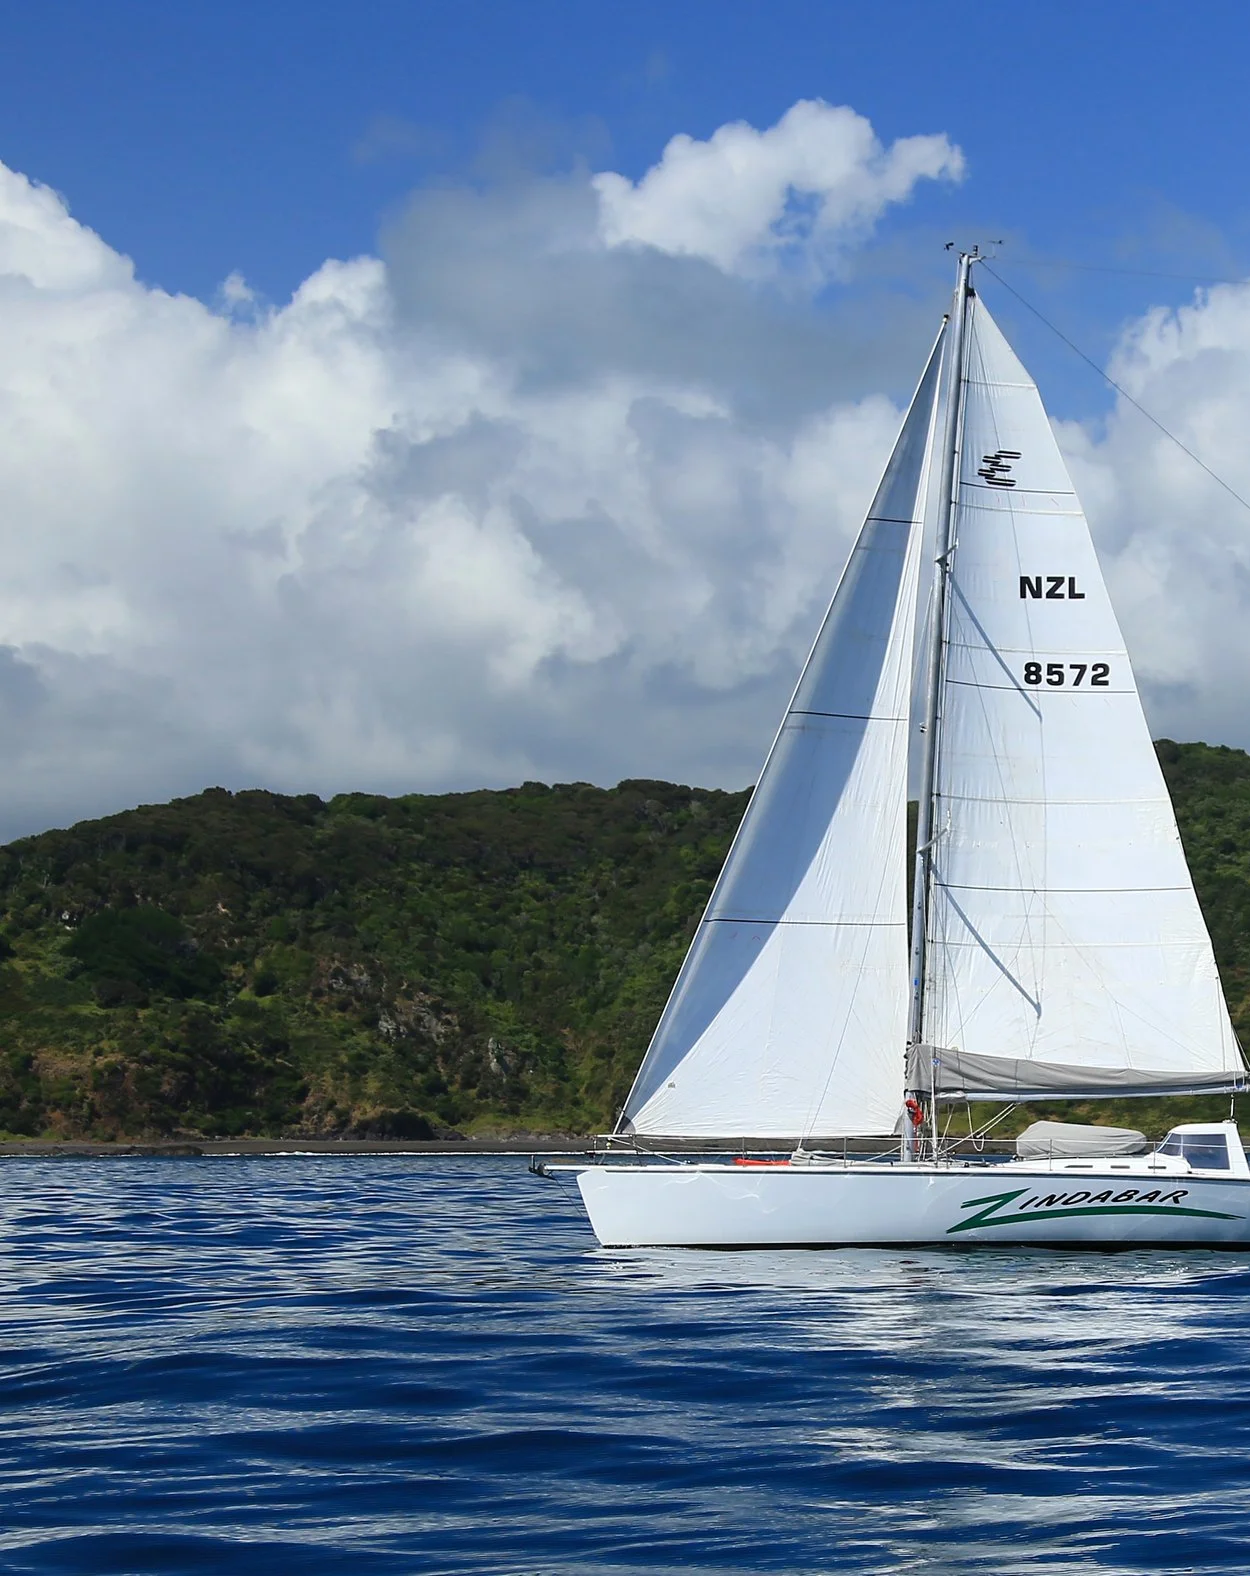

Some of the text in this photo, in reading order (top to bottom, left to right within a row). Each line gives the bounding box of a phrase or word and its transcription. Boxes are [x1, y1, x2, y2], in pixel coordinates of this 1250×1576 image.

[1019, 576, 1086, 599] NZL
[1023, 661, 1110, 686] 8572
[946, 1186, 1247, 1234] ZINDABAR
